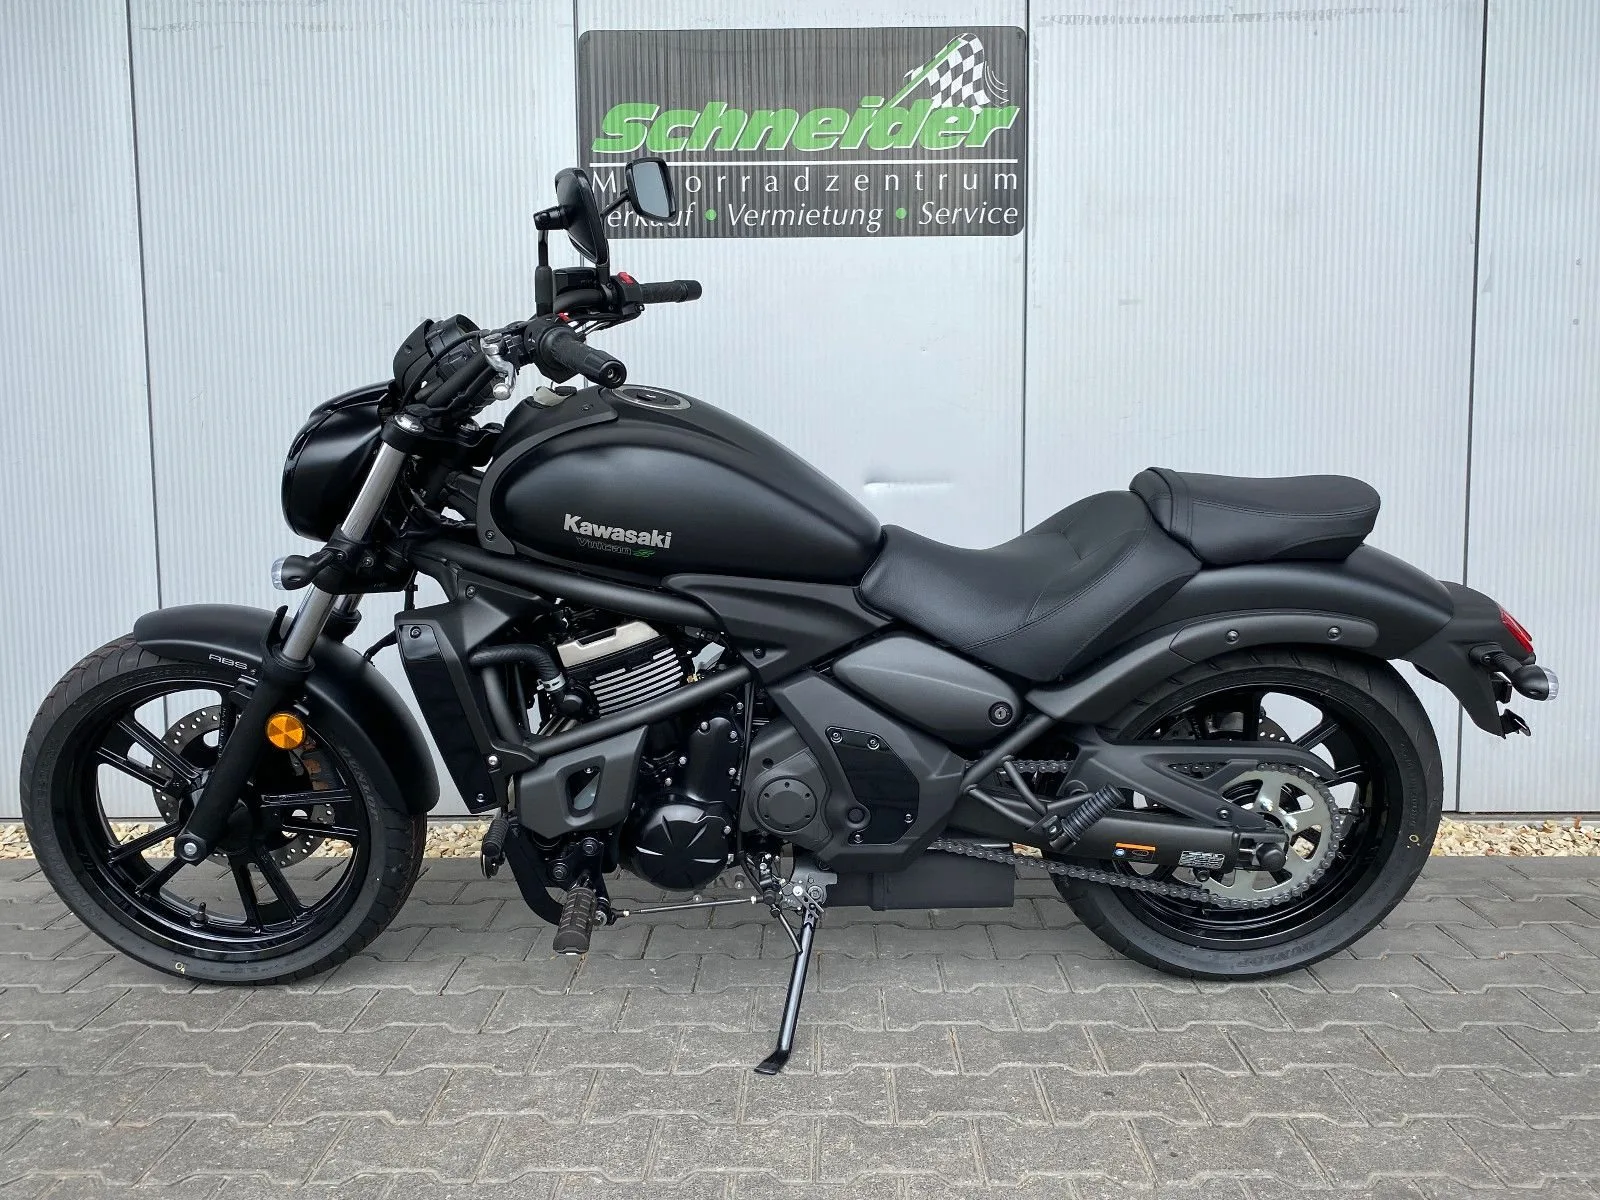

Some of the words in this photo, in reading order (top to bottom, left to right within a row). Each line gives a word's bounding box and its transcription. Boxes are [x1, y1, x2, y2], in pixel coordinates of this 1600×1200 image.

[591, 95, 1020, 153] Schneider
[592, 166, 1018, 193] Morradzentrum
[728, 202, 884, 233] Vermietung
[918, 201, 1018, 225] Service
[563, 513, 672, 549] Kawasaki
[209, 653, 248, 670] ABS
